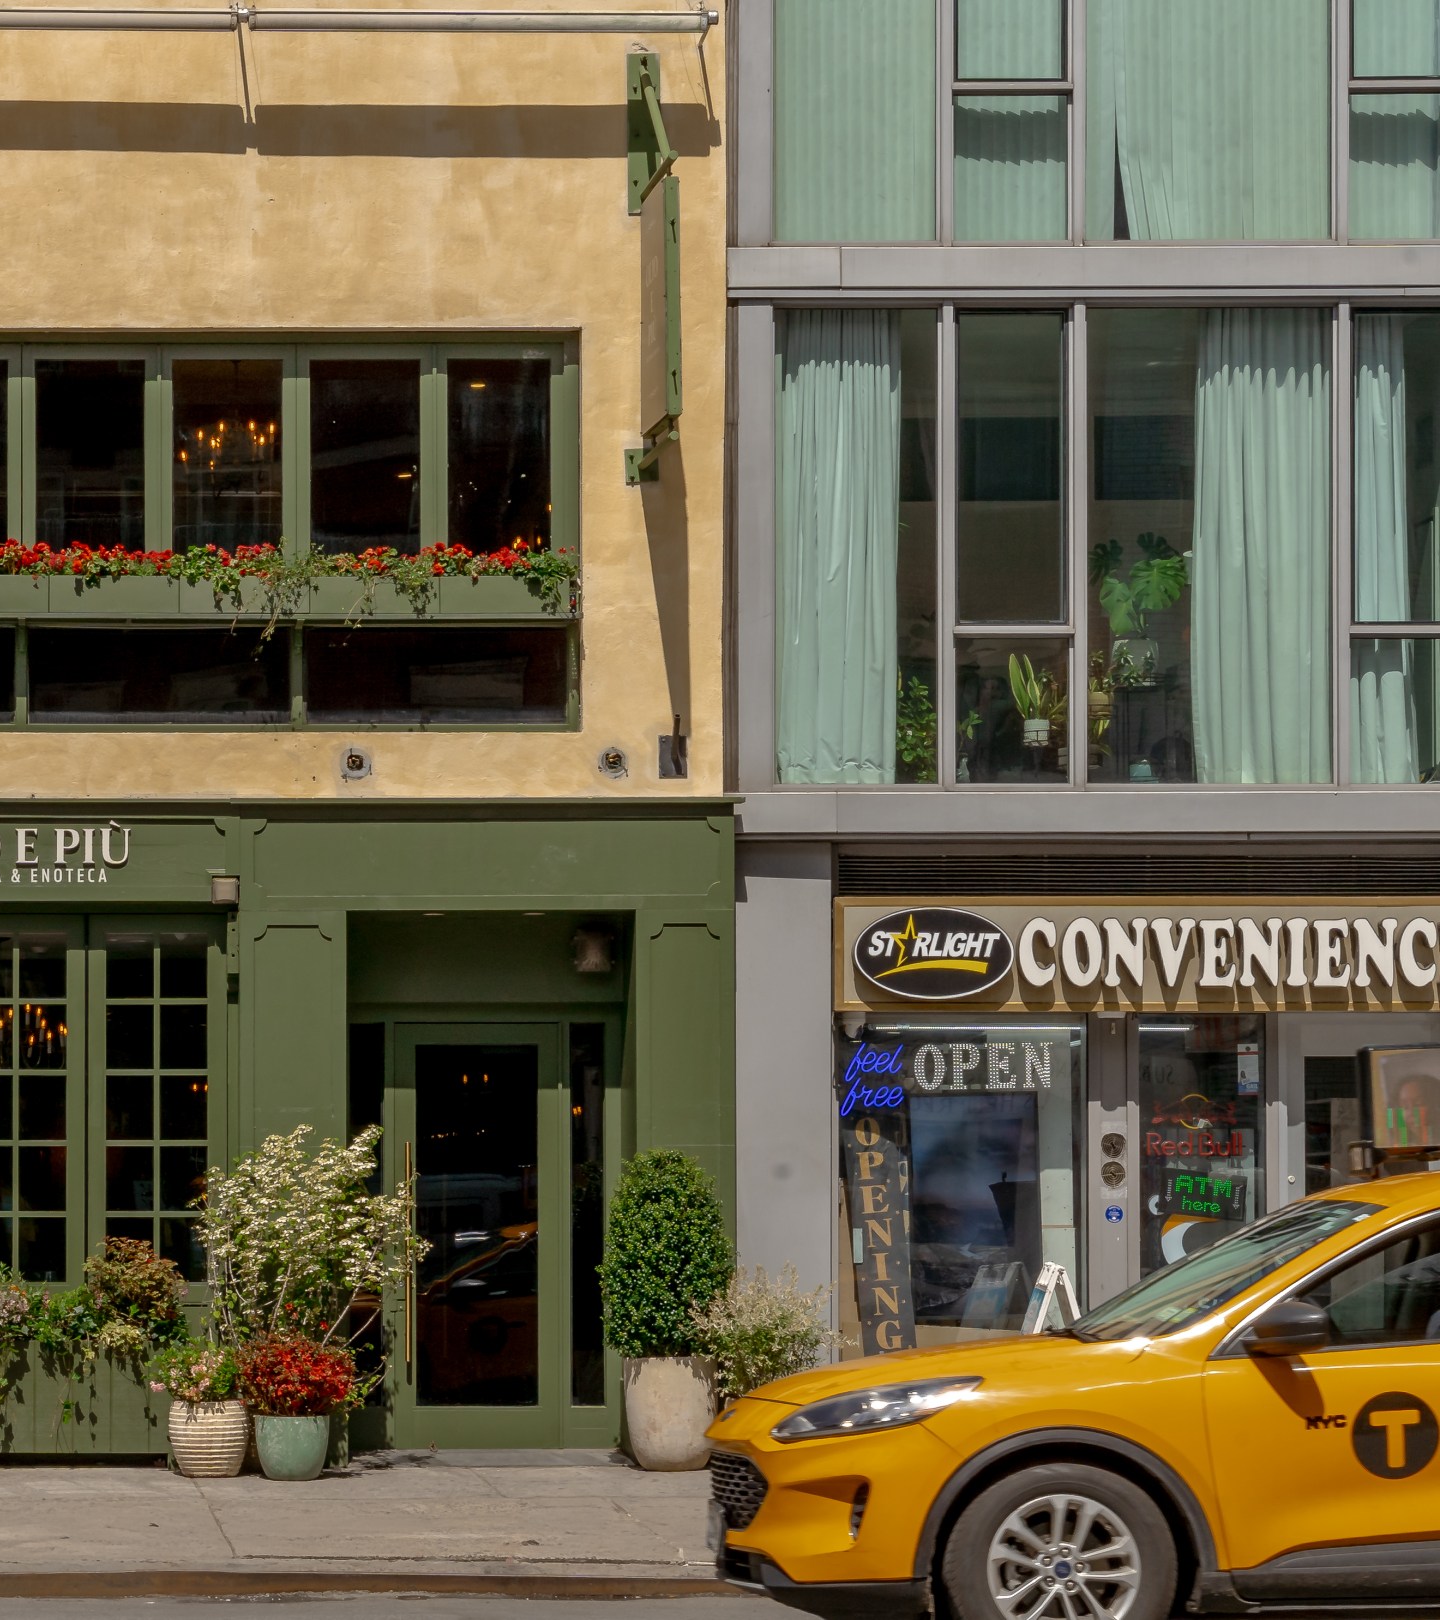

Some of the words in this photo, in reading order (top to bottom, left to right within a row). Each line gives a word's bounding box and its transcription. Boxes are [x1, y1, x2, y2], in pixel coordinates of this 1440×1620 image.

[15, 828, 39, 866] E
[54, 819, 132, 867] PIÙ
[10, 868, 21, 883] &
[30, 868, 108, 883] ENOTECA
[1018, 916, 1437, 987] CONVENIENC
[844, 1042, 904, 1082] feel
[914, 1042, 1054, 1091] OPEN
[840, 1077, 905, 1117] free
[1145, 1131, 1193, 1157] Red
[1199, 1131, 1243, 1157] Bull
[1175, 1174, 1233, 1198] ATM
[1182, 1195, 1221, 1213] here
[854, 1117, 904, 1350] OPENING
[1304, 1414, 1347, 1431] NYC
[1368, 1408, 1421, 1469] T
